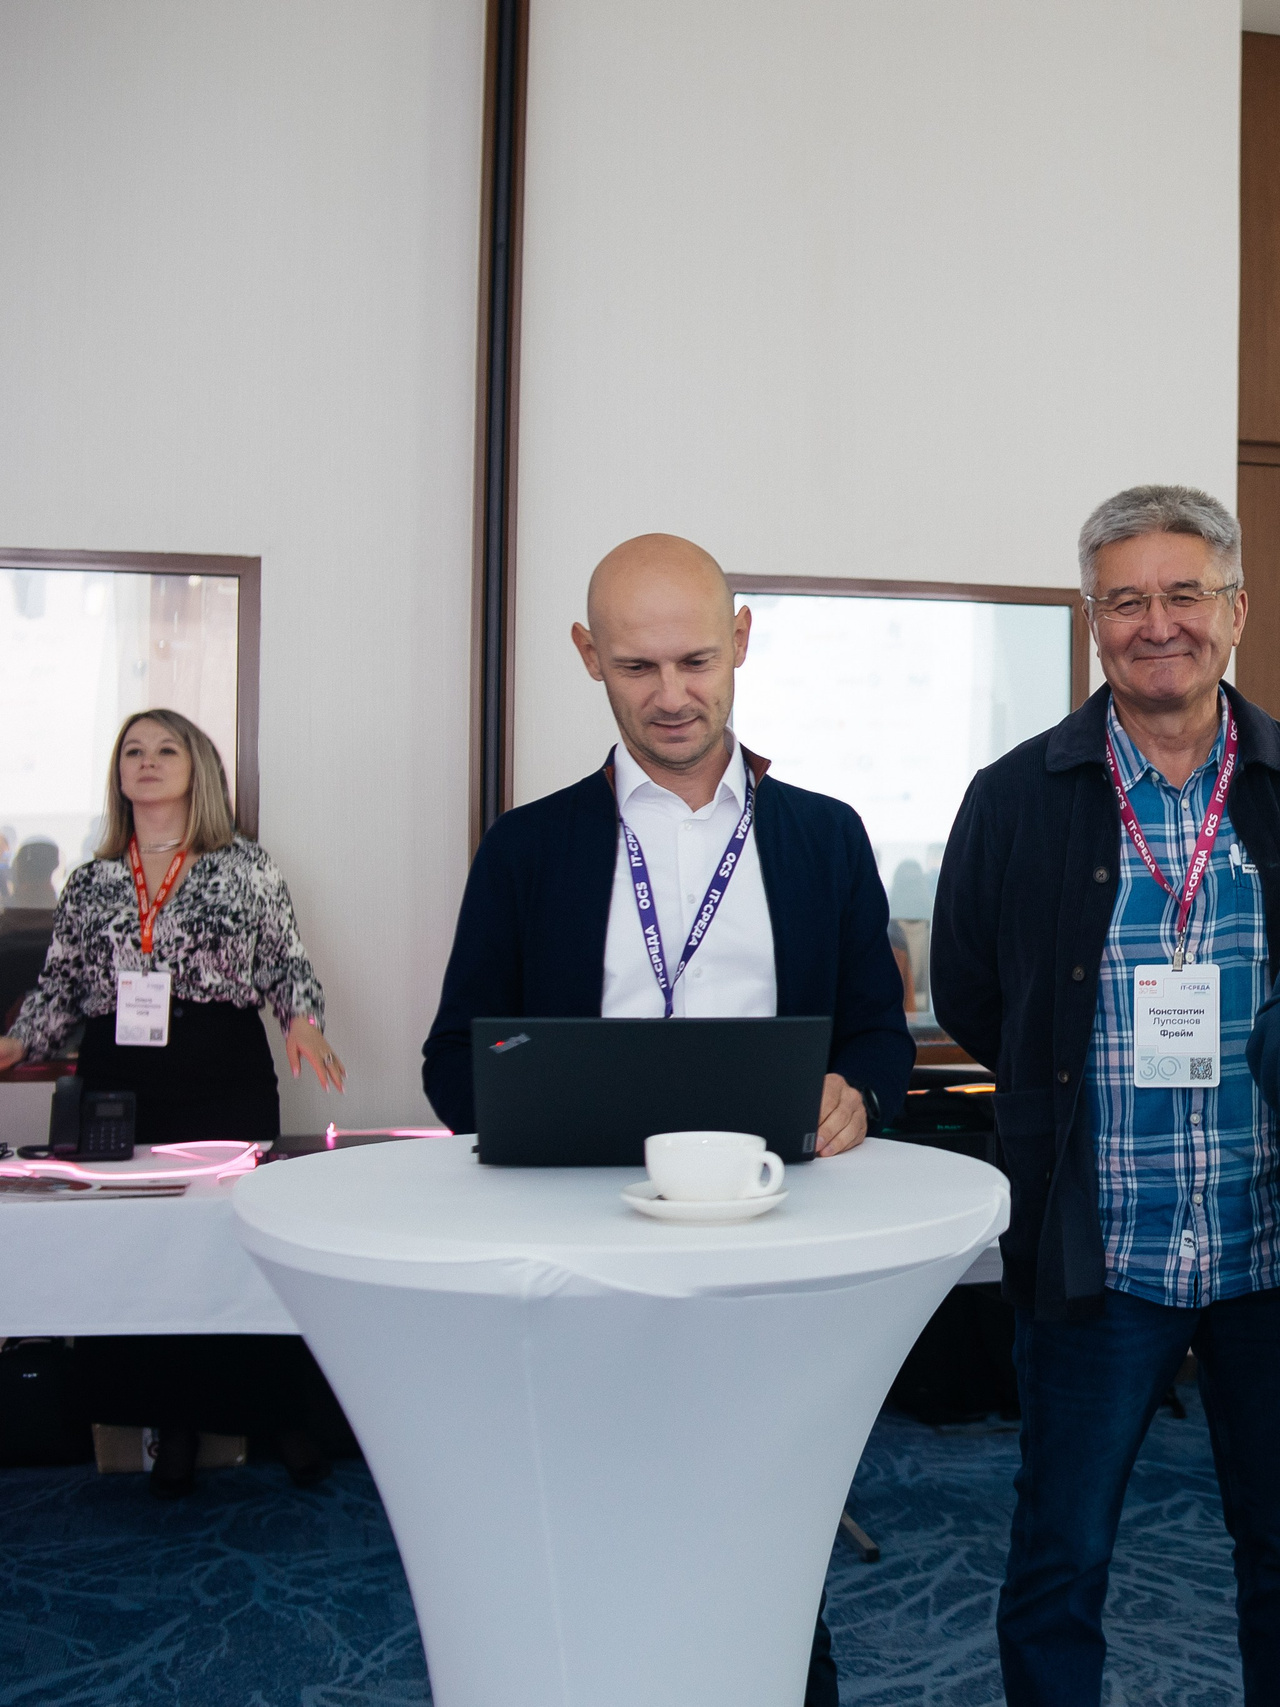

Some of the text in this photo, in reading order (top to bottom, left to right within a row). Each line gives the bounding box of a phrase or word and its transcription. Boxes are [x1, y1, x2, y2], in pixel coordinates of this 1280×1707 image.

[1185, 849, 1209, 902] IT-СРЕДА
[1205, 813, 1218, 837] OCS
[1215, 753, 1235, 803] IT-СРЕДА
[1127, 819, 1156, 873] IT-СРЕДА
[719, 852, 736, 878] OCS
[635, 881, 651, 910] OCS
[688, 888, 721, 946] IT-СРЕДА
[644, 925, 667, 989] IT-СРЕДА
[1148, 1007, 1205, 1015] Константин
[1153, 1017, 1201, 1026] Лупсанов
[1160, 1029, 1194, 1039] Фрейм
[1140, 1056, 1181, 1081] 30
